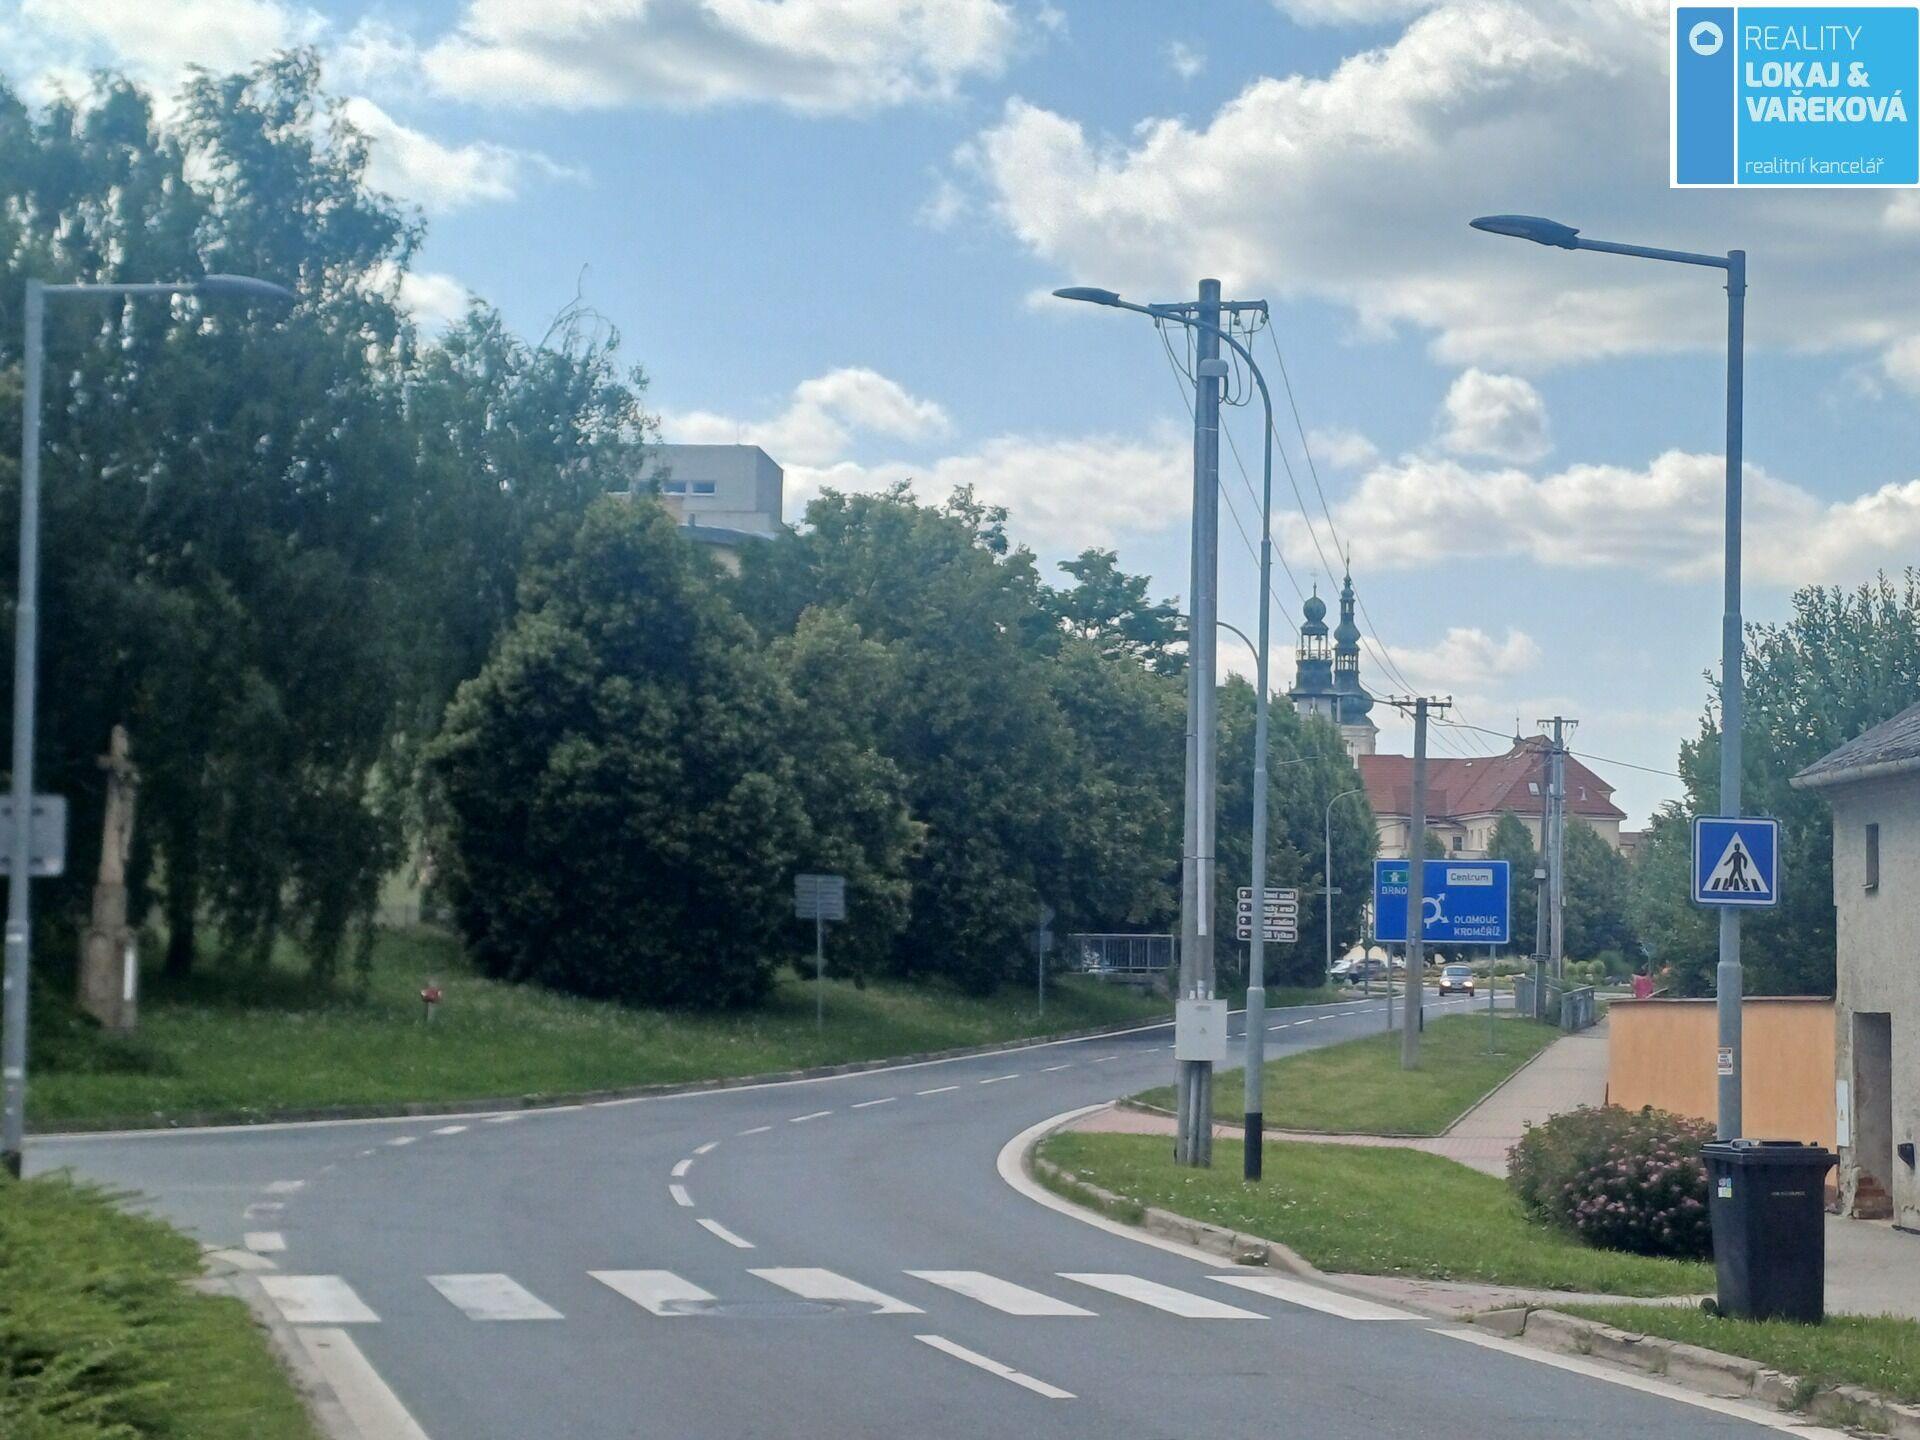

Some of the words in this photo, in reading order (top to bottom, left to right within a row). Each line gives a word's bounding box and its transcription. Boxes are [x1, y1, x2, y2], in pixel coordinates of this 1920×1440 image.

[1450, 872, 1489, 881] Centrum
[1381, 886, 1408, 895] BRNO
[1453, 915, 1499, 924] OLOMOUC
[1453, 925, 1501, 937] KROMĚŘÍŽ
